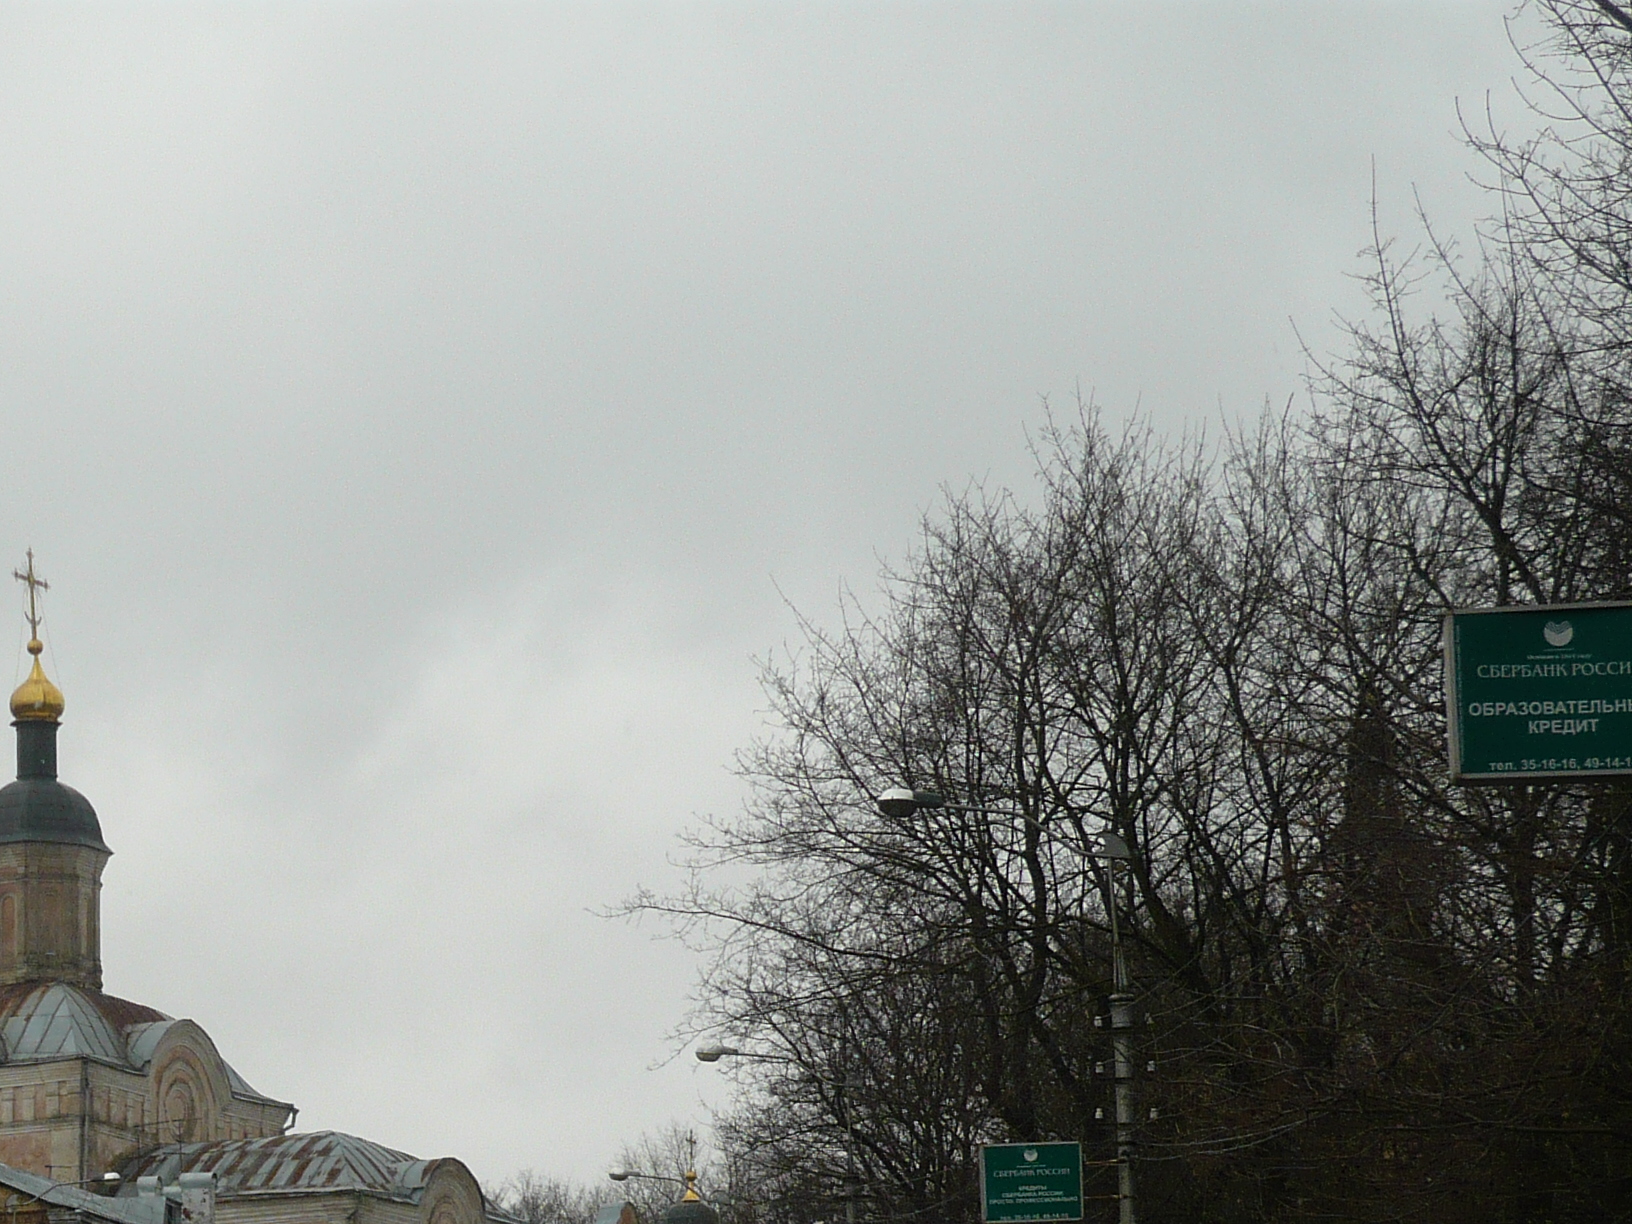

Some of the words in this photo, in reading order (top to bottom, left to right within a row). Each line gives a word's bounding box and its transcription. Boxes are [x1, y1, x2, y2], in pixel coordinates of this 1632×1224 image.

[1477, 664, 1568, 678] СБЕРБАНК
[1528, 719, 1599, 735] КРЕДИТ
[1583, 756, 1632, 769] 49-14-1
